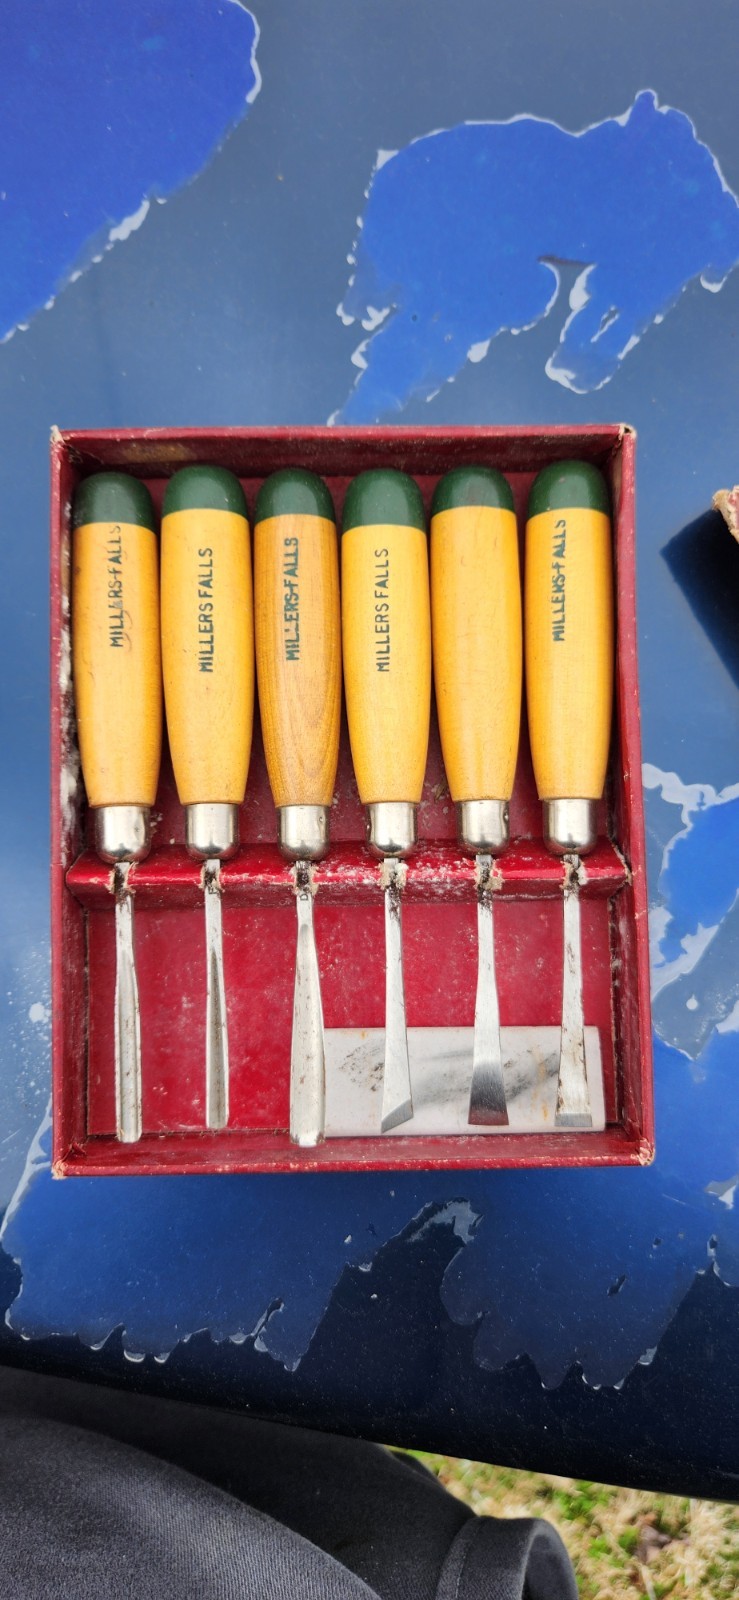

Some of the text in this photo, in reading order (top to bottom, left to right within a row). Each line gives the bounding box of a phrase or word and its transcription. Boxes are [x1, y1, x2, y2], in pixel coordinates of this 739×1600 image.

[198, 548, 214, 673] MILLERS FALLS
[374, 548, 391, 673] MILLERS FALLS
